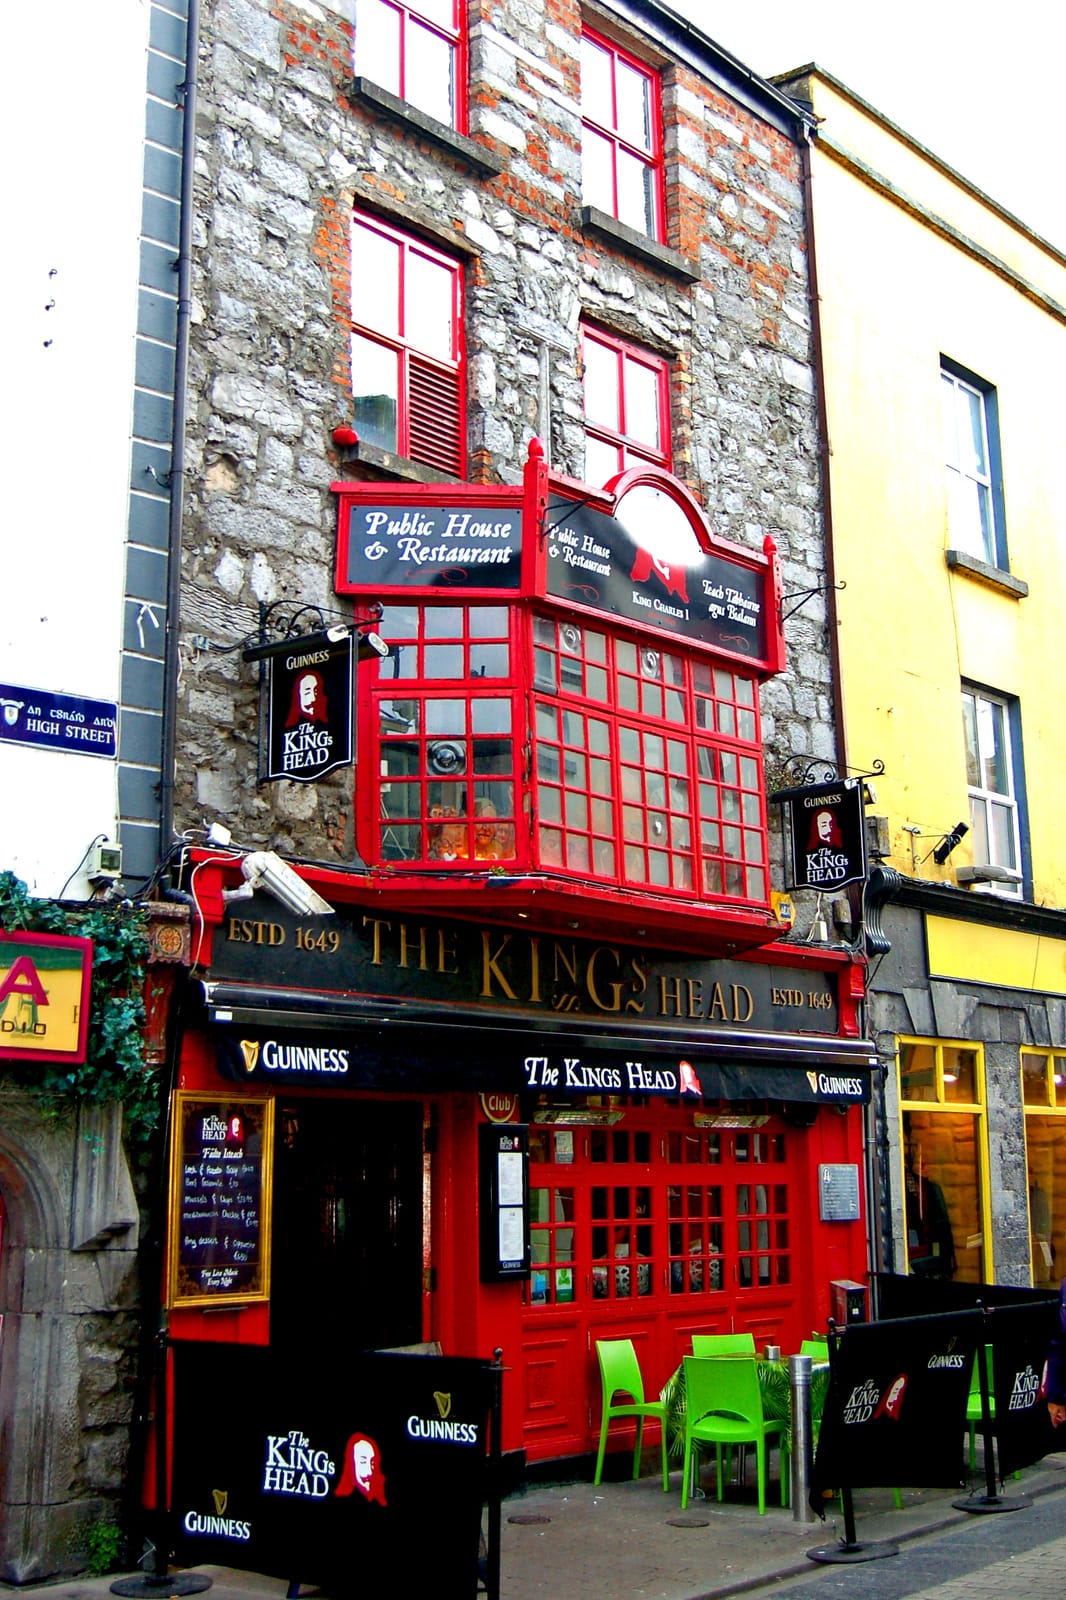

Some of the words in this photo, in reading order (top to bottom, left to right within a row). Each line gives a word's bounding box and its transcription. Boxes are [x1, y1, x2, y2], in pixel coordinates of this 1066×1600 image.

[365, 512, 435, 536] Public
[441, 514, 512, 538] House
[364, 541, 388, 560] &
[397, 537, 512, 565] Restaurant
[548, 523, 580, 548] Public
[581, 535, 611, 560] House
[548, 544, 560, 558] &
[563, 546, 612, 577] Restaurant
[632, 591, 652, 608] KING
[286, 650, 330, 670] GUINNESS
[26, 718, 60, 735] HIGH
[65, 725, 113, 744] STREET
[299, 722, 315, 735] The
[283, 749, 329, 771] HEAD
[804, 793, 842, 808] GUINNESS
[807, 867, 846, 882] HEAD
[228, 917, 286, 947] ESTD
[296, 926, 341, 954] 1649
[362, 915, 460, 975] THE
[479, 931, 648, 1014] KINGS
[657, 975, 754, 1023] HEAD
[771, 987, 804, 1008] ESTD
[808, 991, 833, 1010] 1649
[262, 1041, 349, 1073] GUINNESS
[524, 1057, 559, 1086] The
[563, 1058, 622, 1089] KINGS
[625, 1062, 677, 1090] HEAD
[818, 1073, 862, 1096] GUINNESS
[488, 1095, 511, 1111] Club
[202, 1131, 226, 1140] HEAD
[928, 1355, 965, 1369] GUINNESS
[1008, 1391, 1036, 1410] HEAD
[288, 1430, 310, 1448] The
[407, 1415, 478, 1443] GUINNESS
[263, 1467, 329, 1497] HEAD
[184, 1511, 251, 1540] GUINNESS
